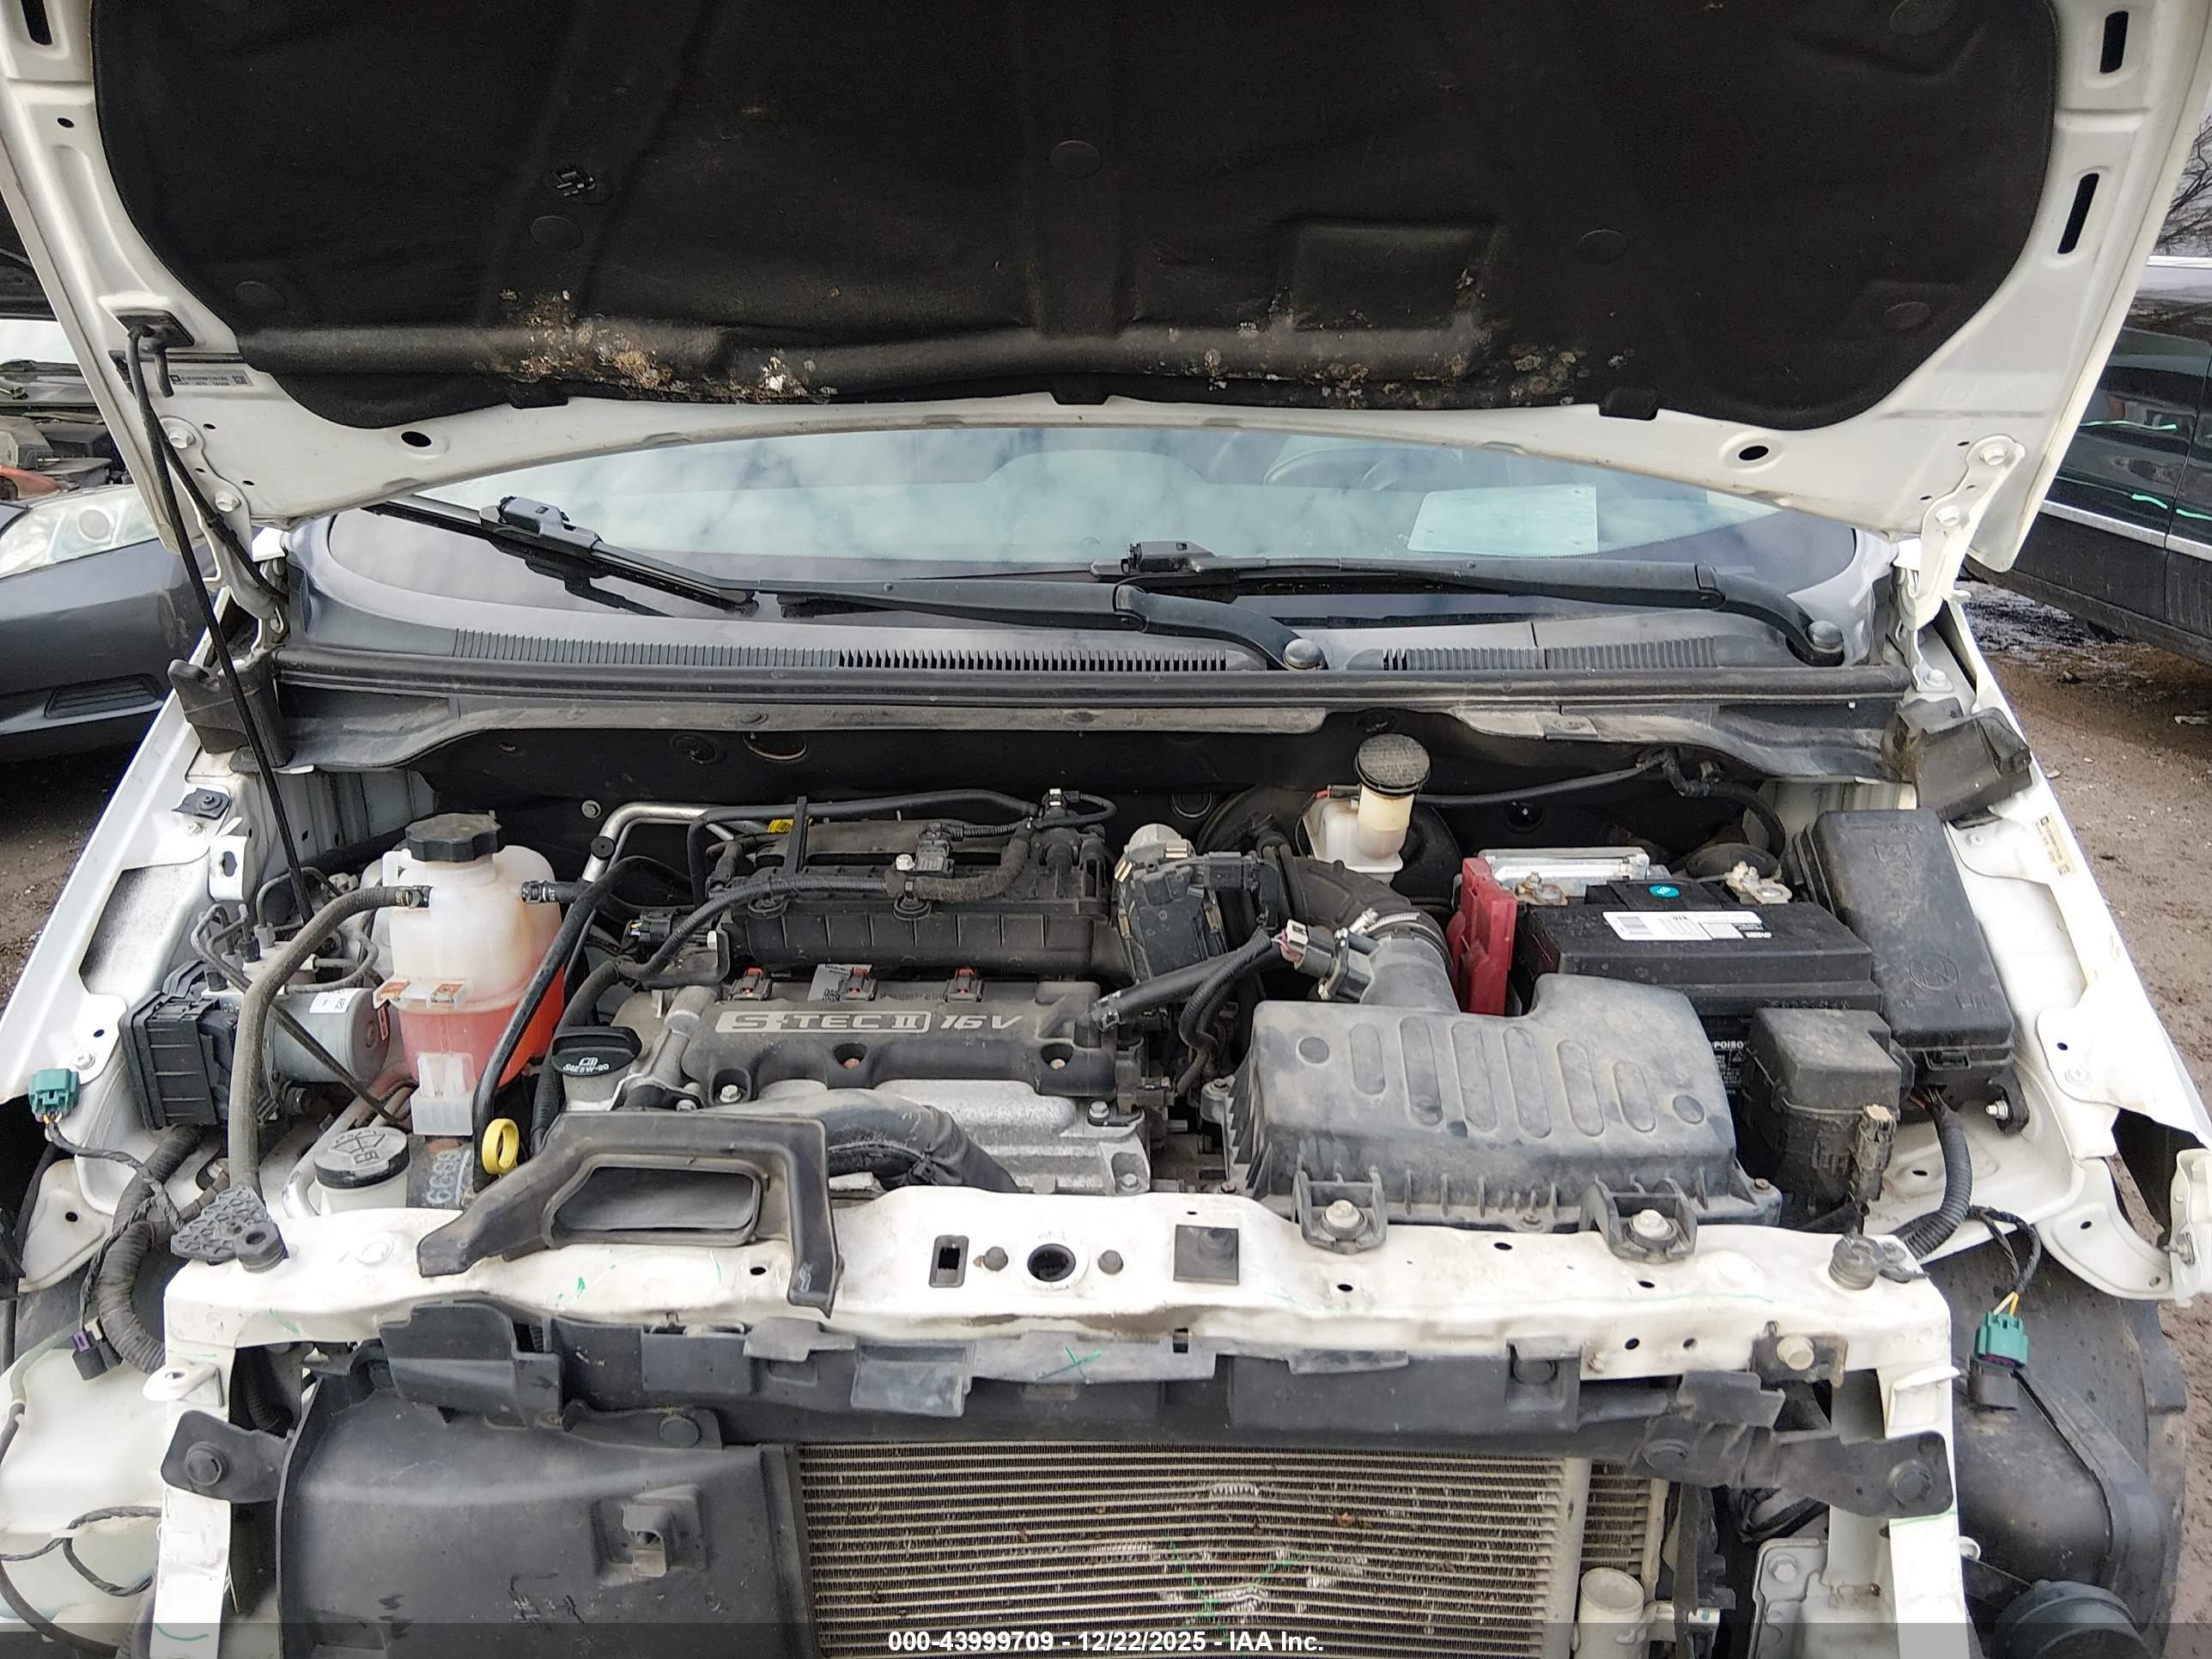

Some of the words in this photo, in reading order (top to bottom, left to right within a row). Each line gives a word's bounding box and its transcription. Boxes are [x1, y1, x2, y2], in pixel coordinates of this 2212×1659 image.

[731, 1014, 882, 1030] S-TEC
[891, 1014, 919, 1030] II
[1713, 1040, 1747, 1049] POISO
